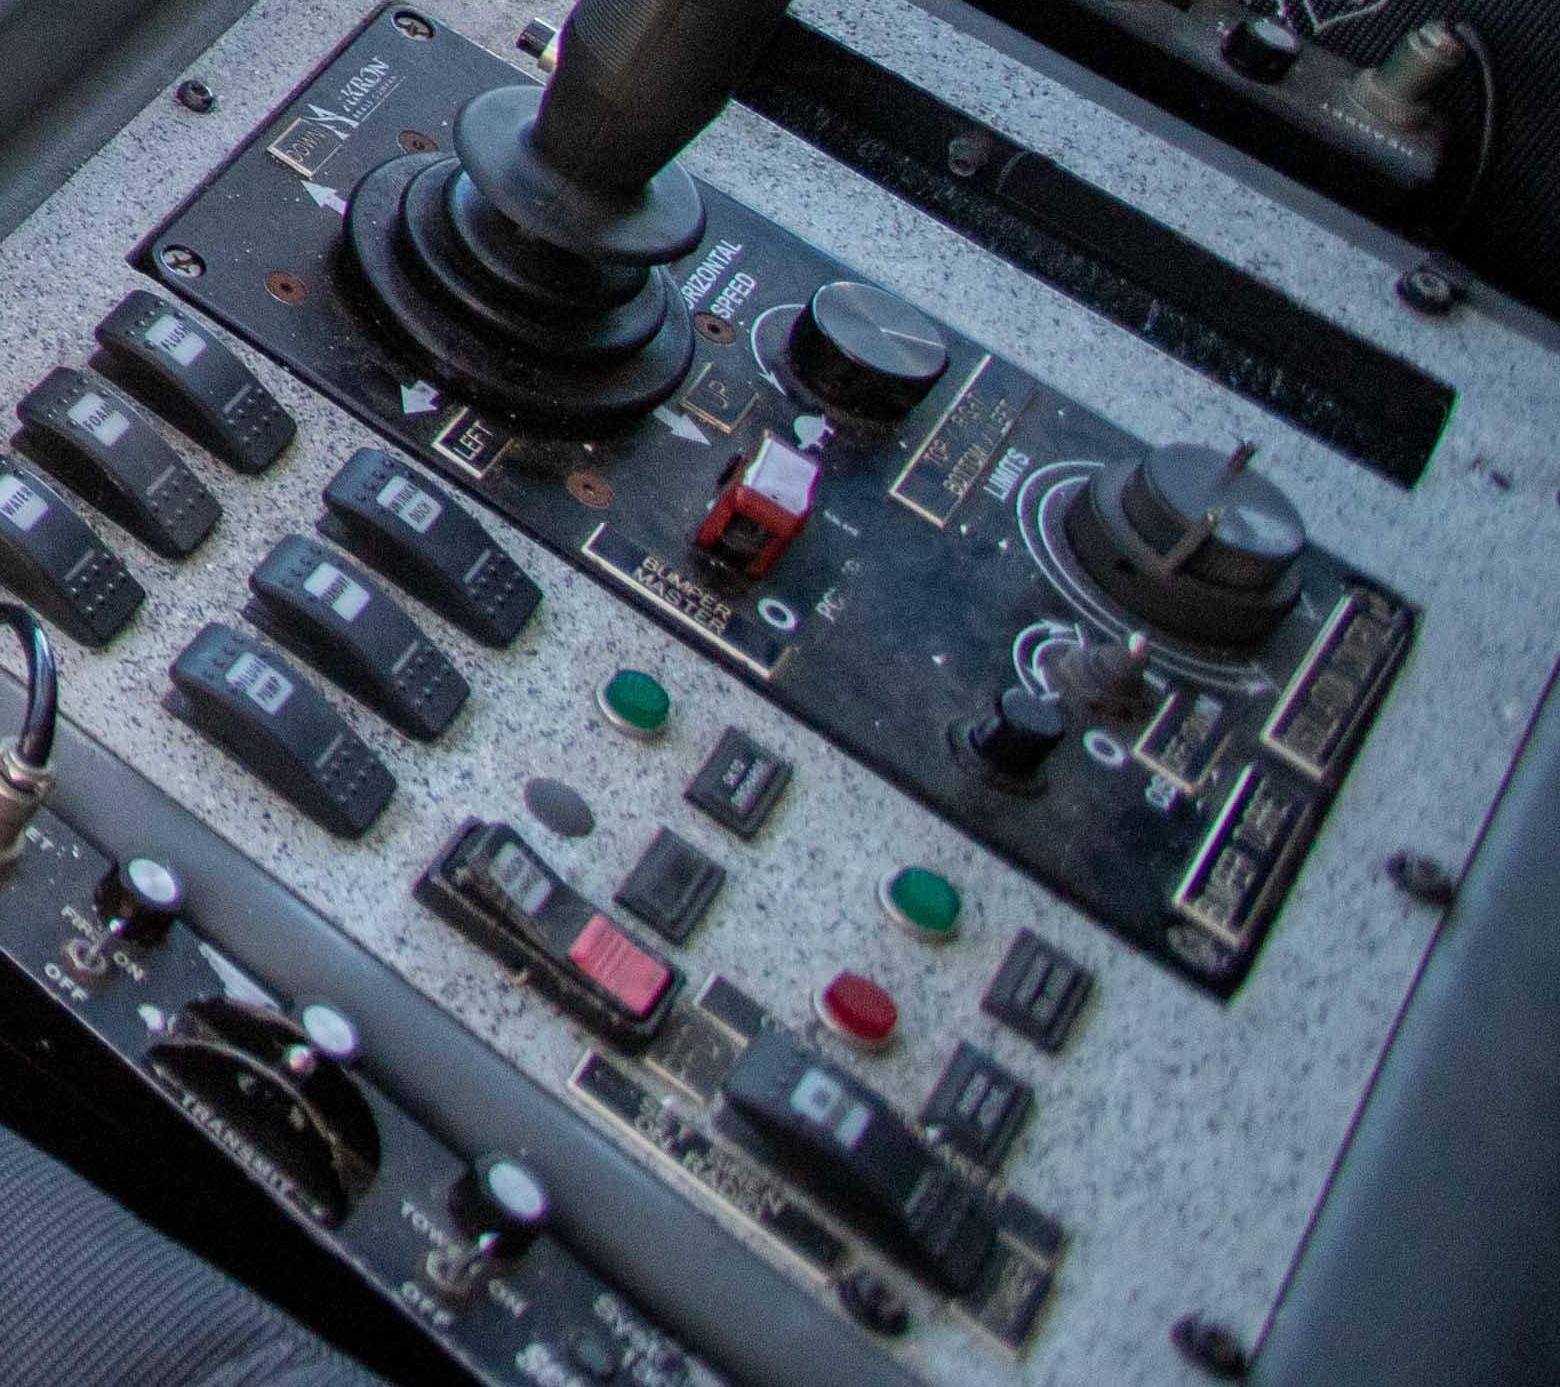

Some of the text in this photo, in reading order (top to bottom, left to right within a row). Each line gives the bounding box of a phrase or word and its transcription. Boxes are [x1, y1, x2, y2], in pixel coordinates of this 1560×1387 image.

[680, 239, 743, 310] ORIZONTAL
[711, 272, 758, 320] SPEED
[453, 420, 494, 462] LEFT
[983, 447, 1031, 502] LIMITS
[642, 555, 733, 620] BUMPER
[43, 961, 90, 1003] OFF
